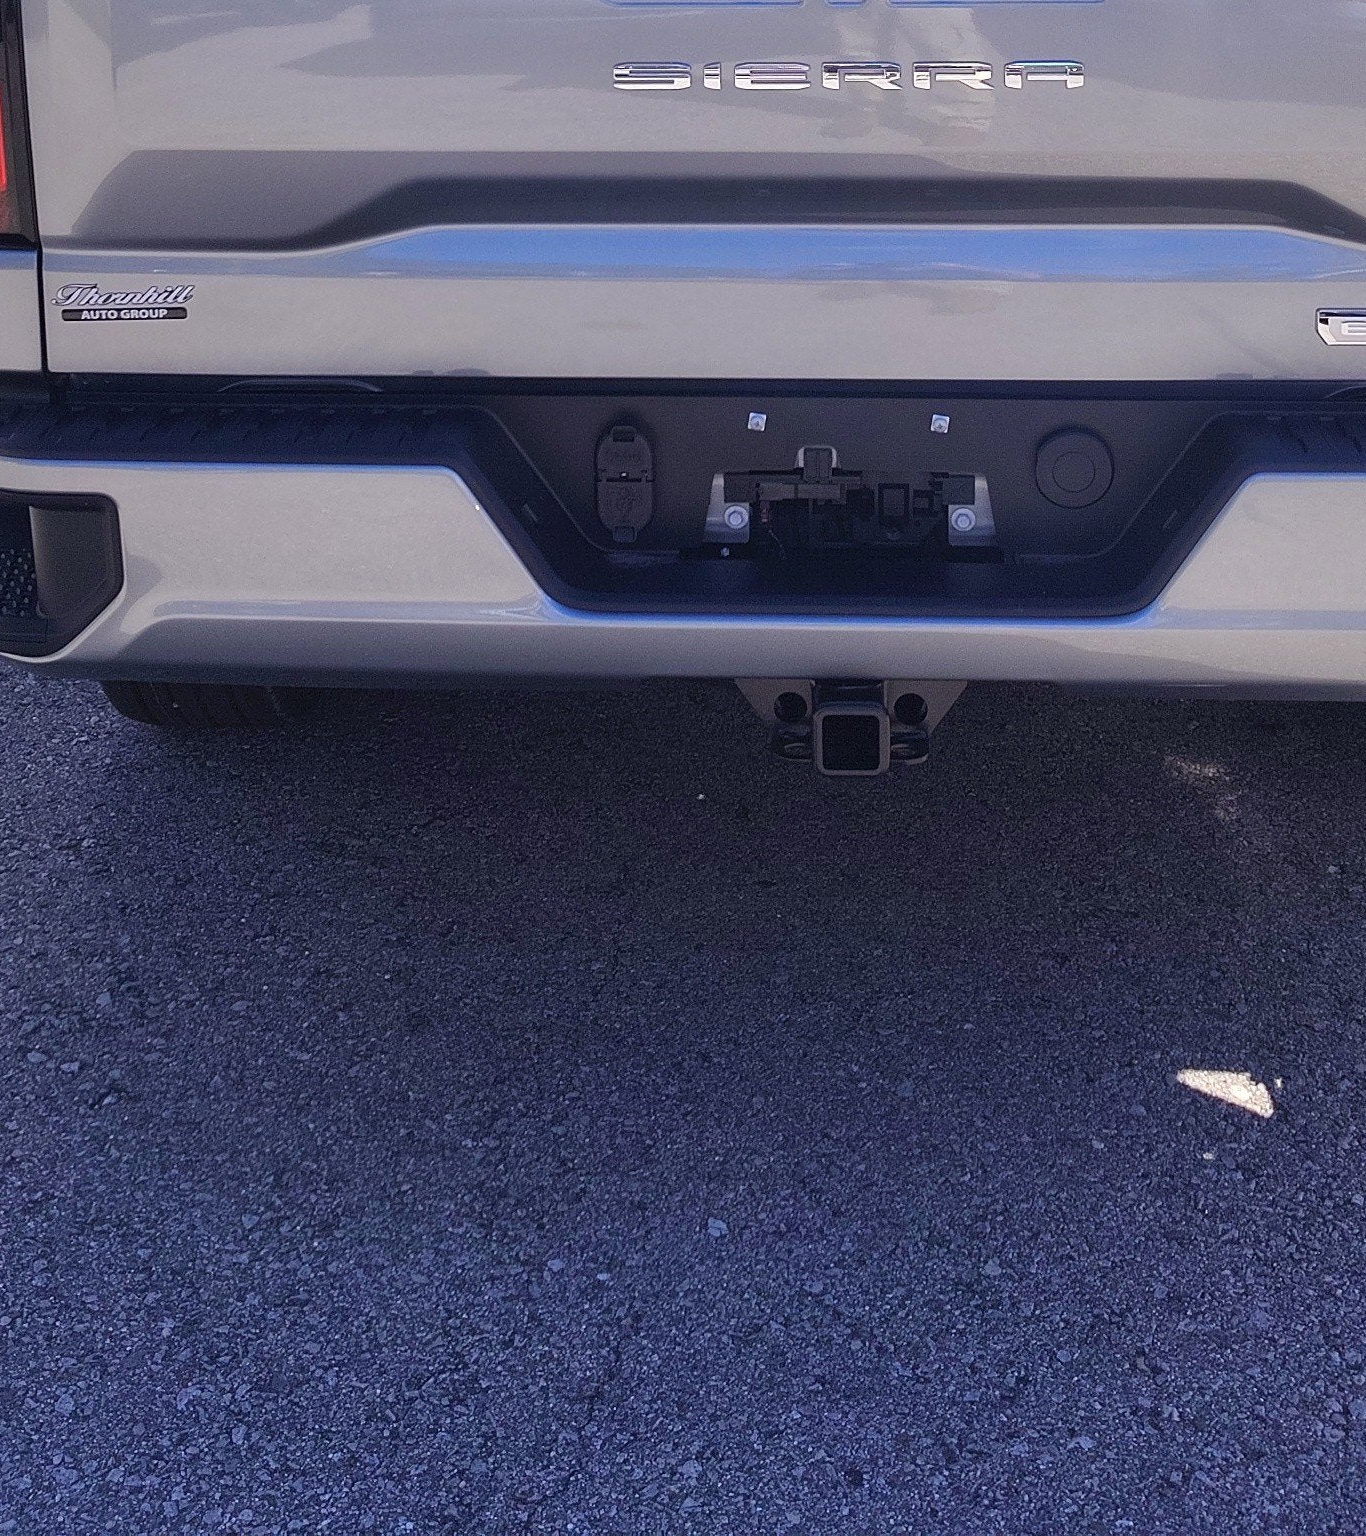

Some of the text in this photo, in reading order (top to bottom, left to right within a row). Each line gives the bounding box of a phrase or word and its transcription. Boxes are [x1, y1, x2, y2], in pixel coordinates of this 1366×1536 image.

[612, 61, 1085, 91] SIERRA
[51, 282, 195, 306] Thornhill
[81, 308, 168, 320] AUTO GROUP
